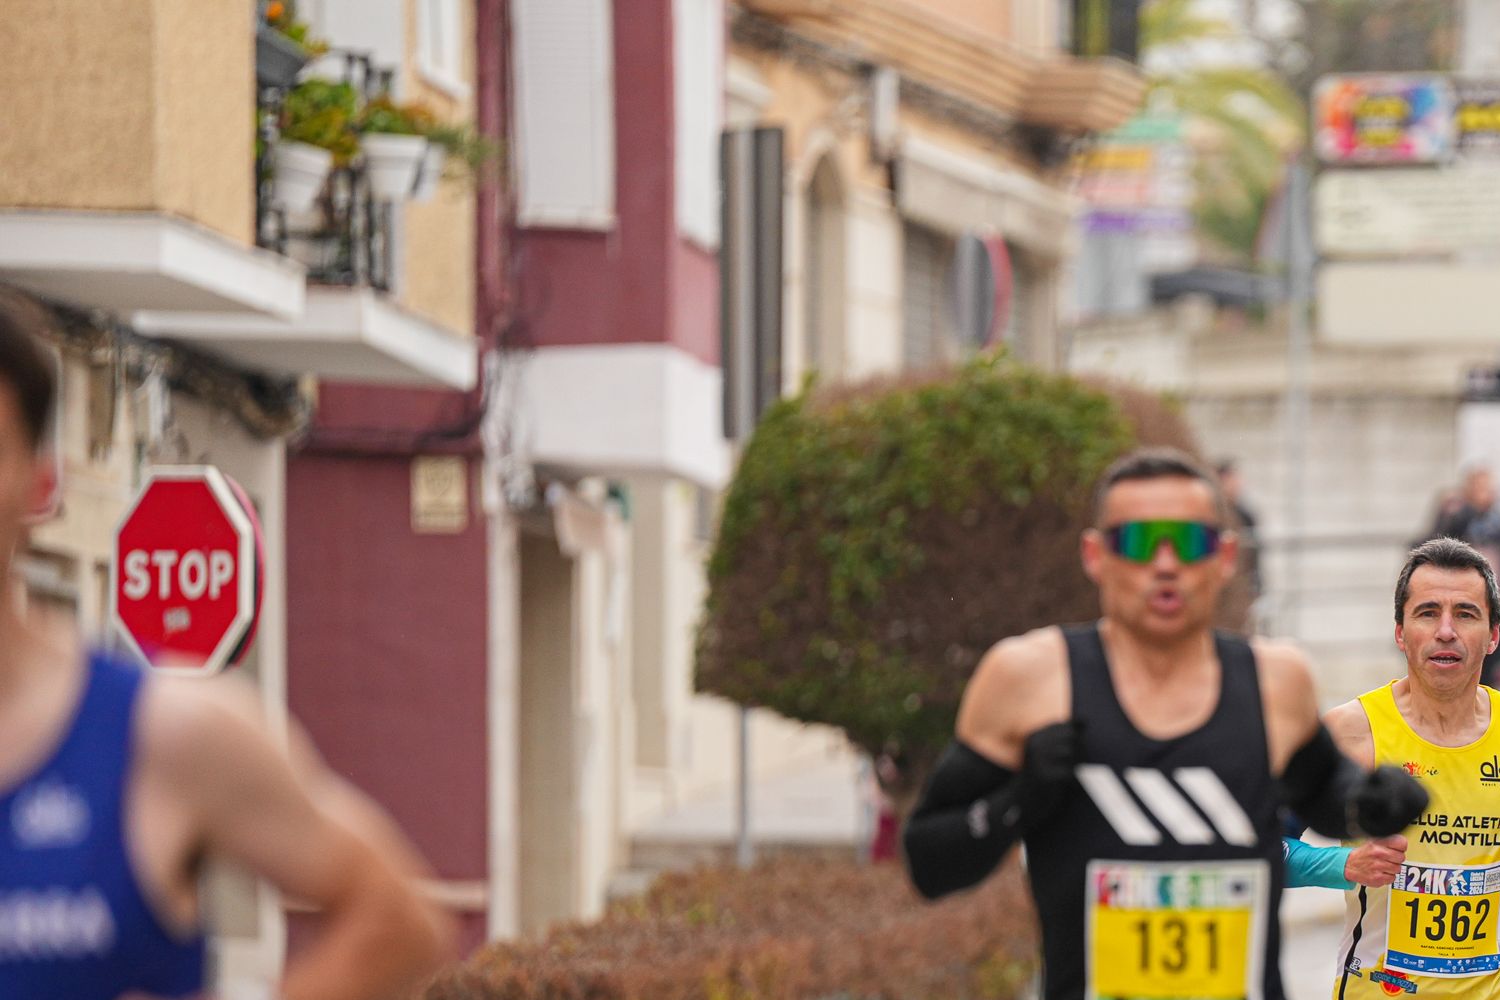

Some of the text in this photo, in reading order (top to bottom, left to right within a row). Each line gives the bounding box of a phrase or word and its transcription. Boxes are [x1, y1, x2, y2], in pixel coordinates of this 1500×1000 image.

[123, 549, 235, 600] STOP
[1406, 867, 1447, 895] 21K
[1405, 897, 1490, 942] 1362
[1131, 917, 1219, 975] 131
